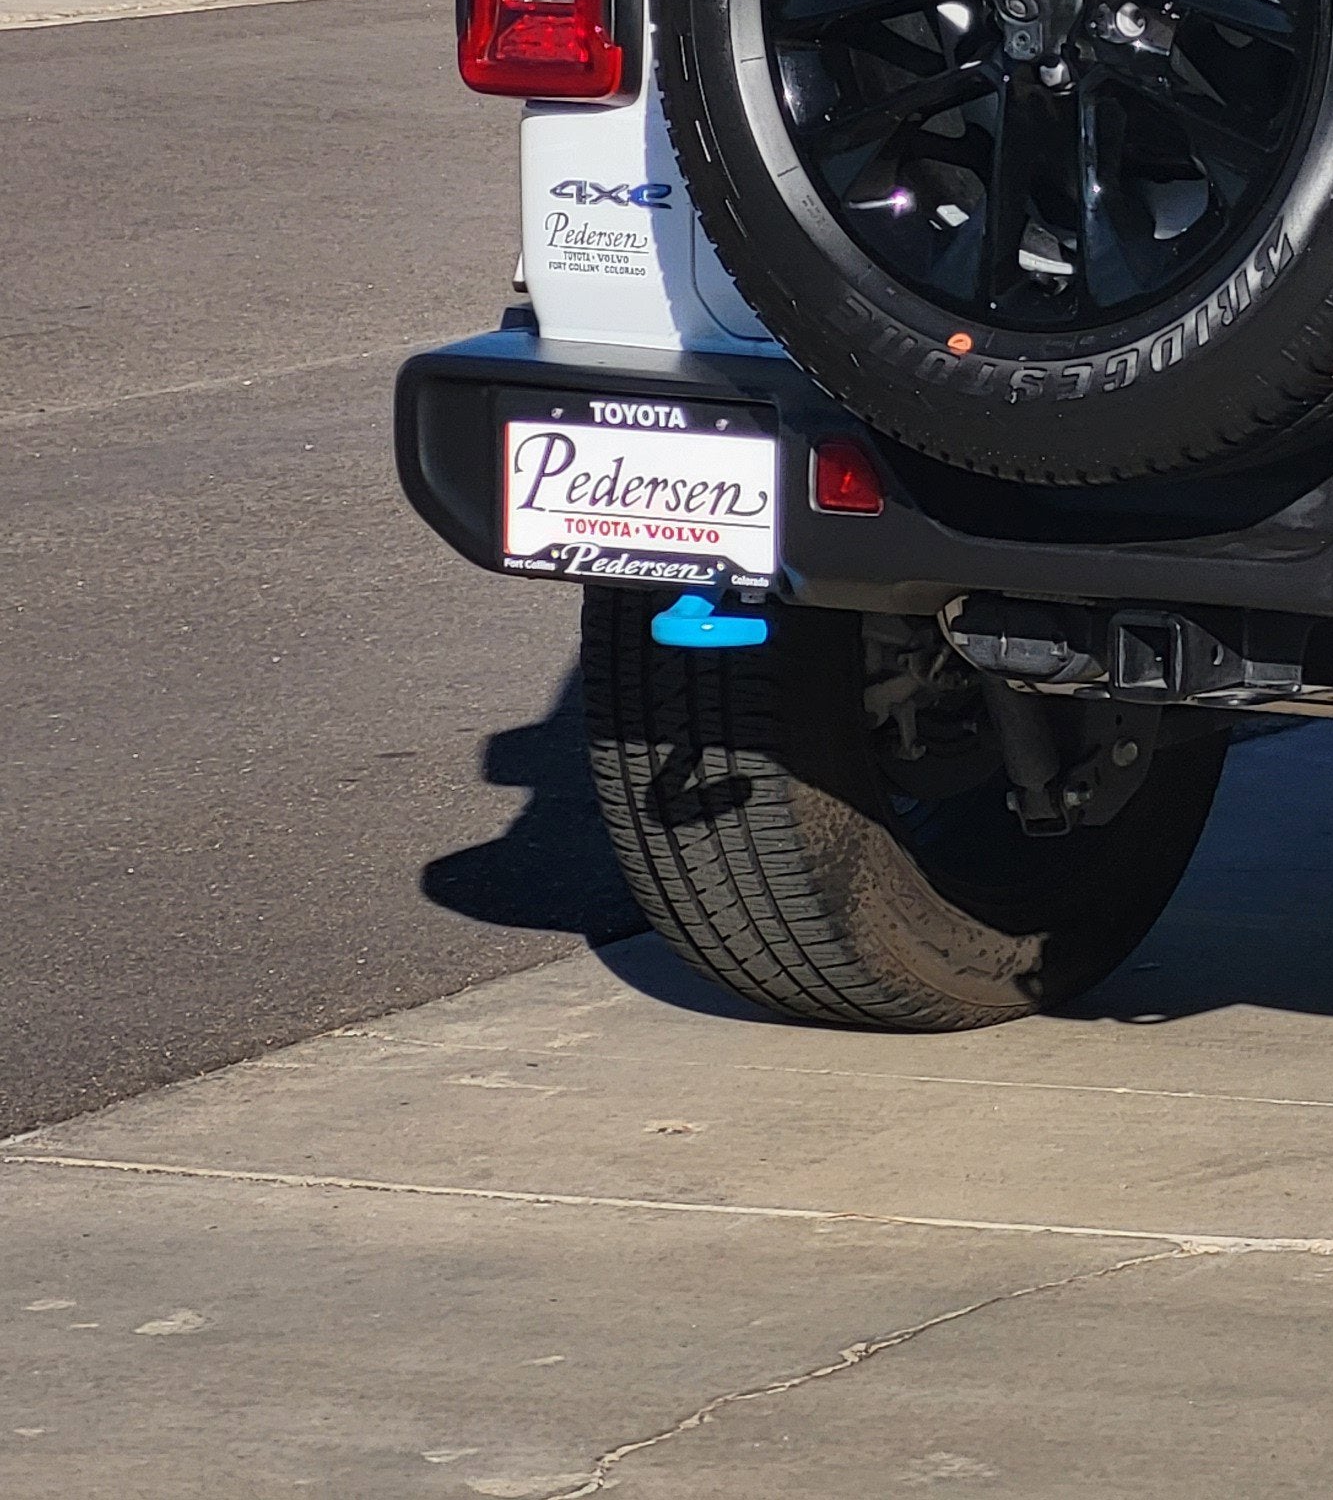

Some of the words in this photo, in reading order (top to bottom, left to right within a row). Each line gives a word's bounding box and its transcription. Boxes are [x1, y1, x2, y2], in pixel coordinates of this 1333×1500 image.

[545, 212, 648, 249] Pedersen
[597, 254, 629, 263] VOLVO
[590, 402, 686, 429] TOYOTA
[514, 432, 768, 517] Pedersen
[564, 518, 631, 538] TOYOTA
[642, 524, 720, 543] VOLVO
[561, 542, 715, 579] Pedersen
